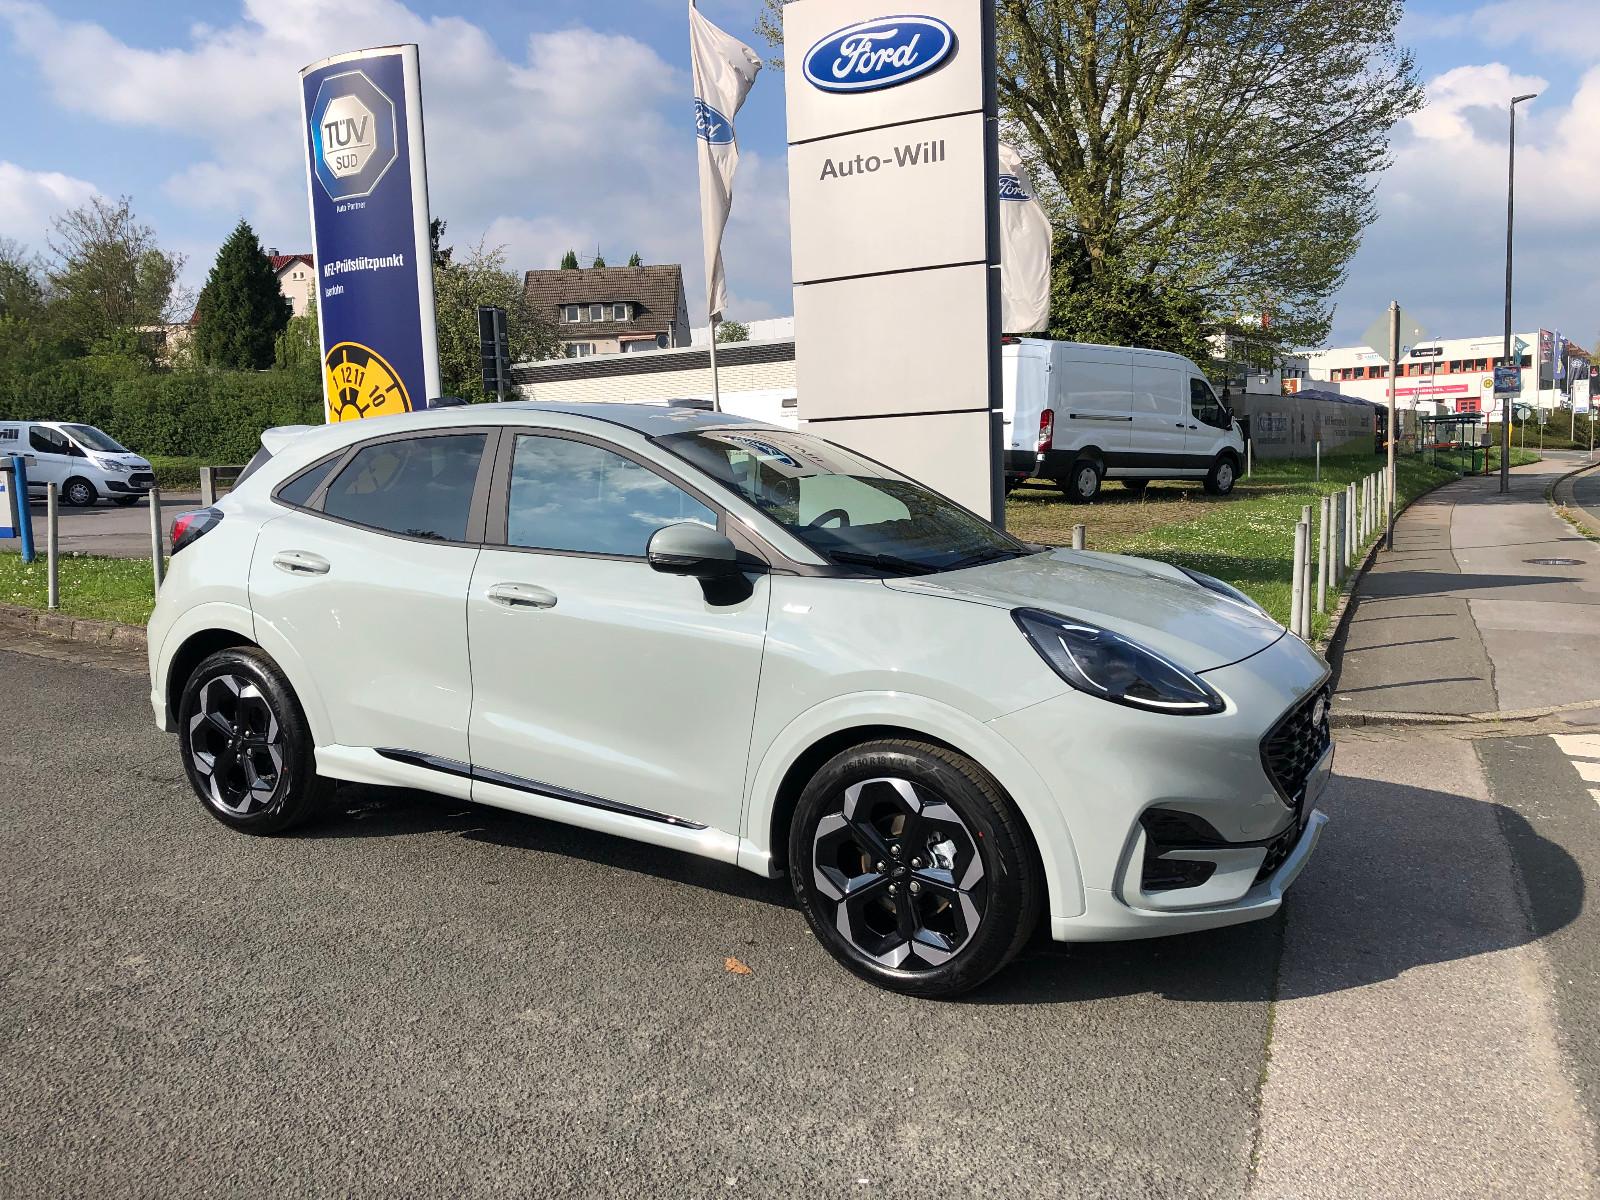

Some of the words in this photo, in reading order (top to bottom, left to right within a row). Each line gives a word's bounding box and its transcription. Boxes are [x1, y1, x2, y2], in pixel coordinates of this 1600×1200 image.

[832, 28, 922, 79] Ford
[324, 115, 369, 148] TÜV
[819, 140, 946, 181] Auto-Will
[323, 253, 405, 277] KFZ-Prüfstützpunkt
[341, 366, 352, 384] 12
[354, 368, 365, 387] 11
[368, 384, 386, 408] 10
[0, 428, 20, 440] ill
